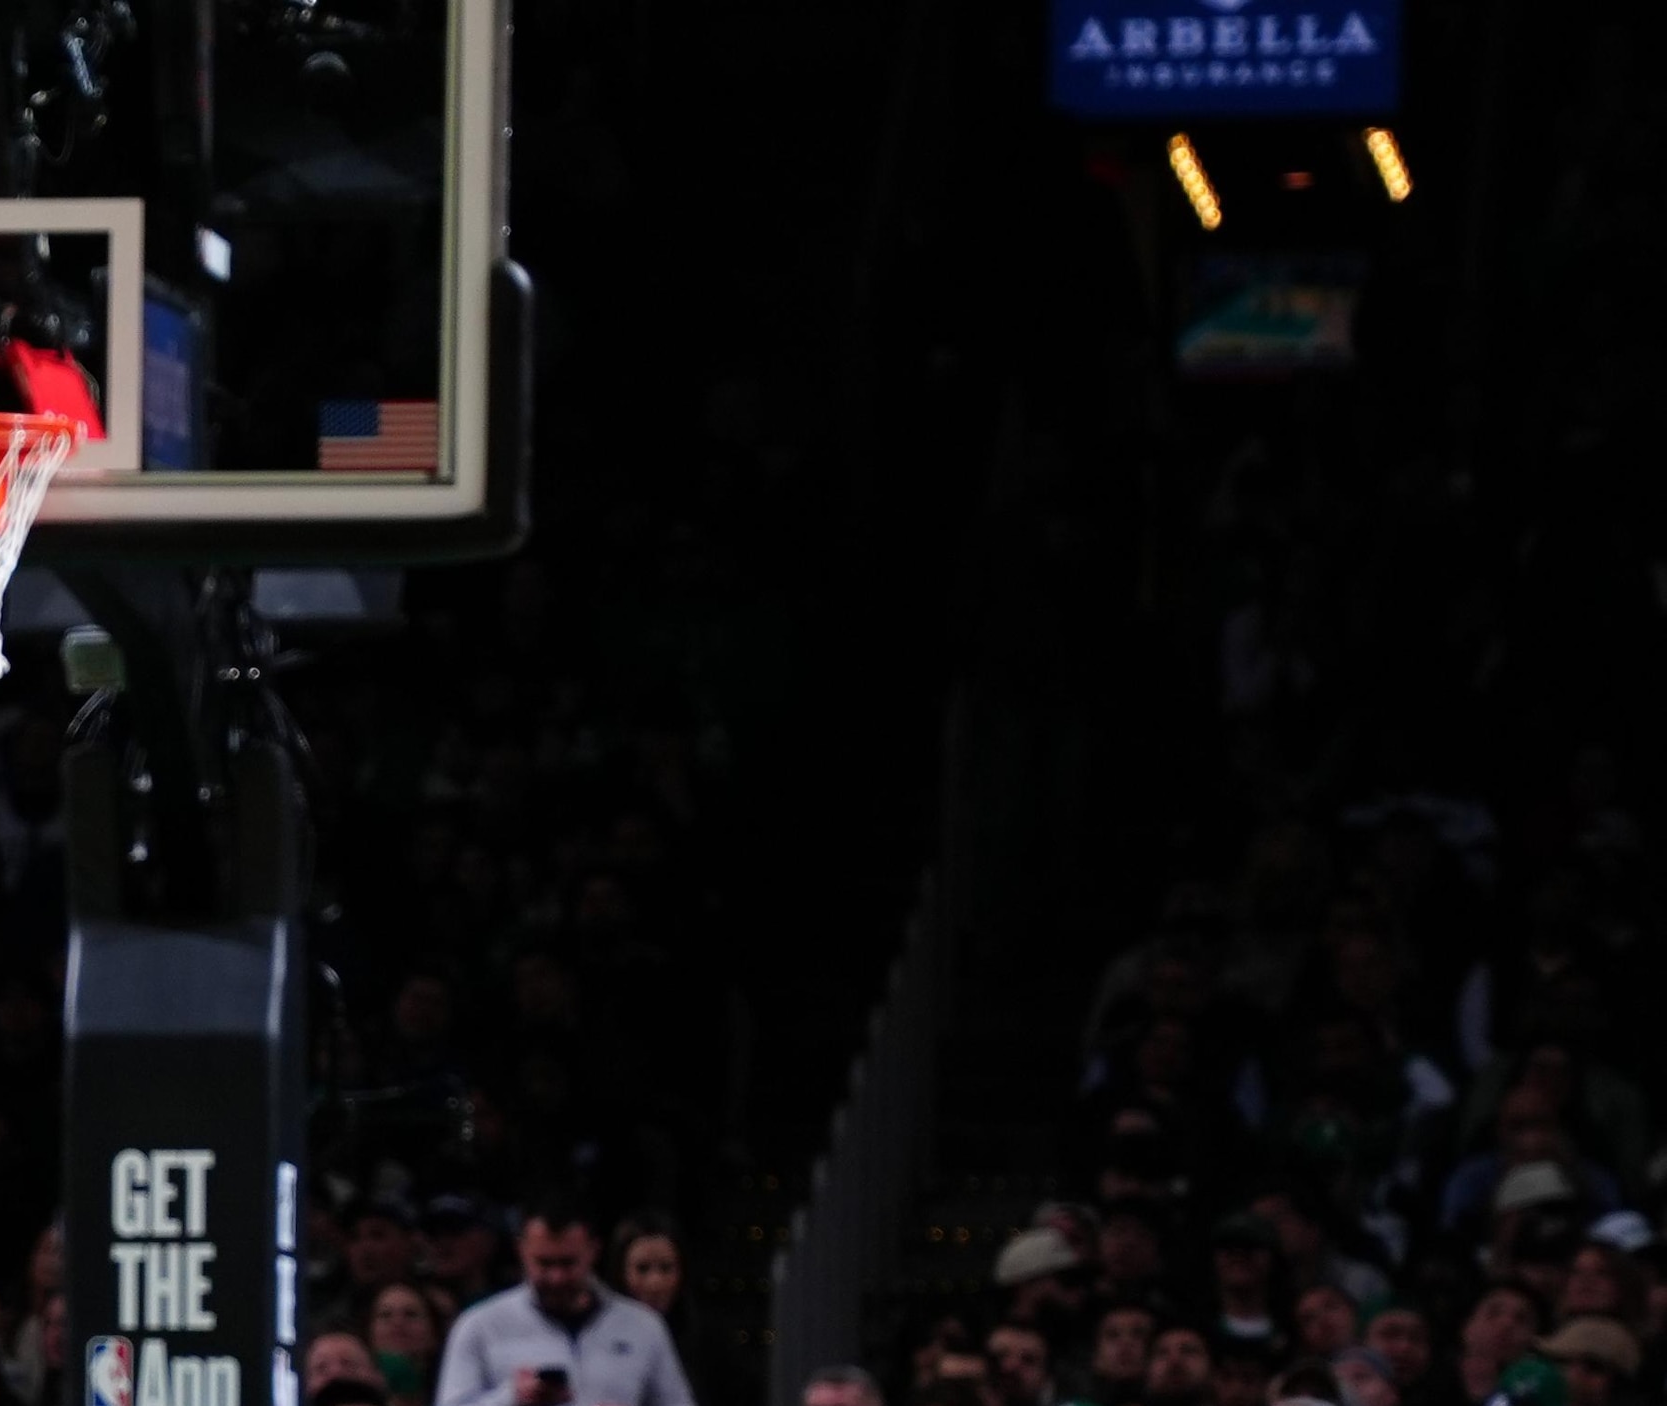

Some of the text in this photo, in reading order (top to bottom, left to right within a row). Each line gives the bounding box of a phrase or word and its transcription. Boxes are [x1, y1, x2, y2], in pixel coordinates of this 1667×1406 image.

[1068, 12, 1379, 60] ARBELLA
[110, 1147, 216, 1239] GET
[109, 1241, 218, 1332] THE
